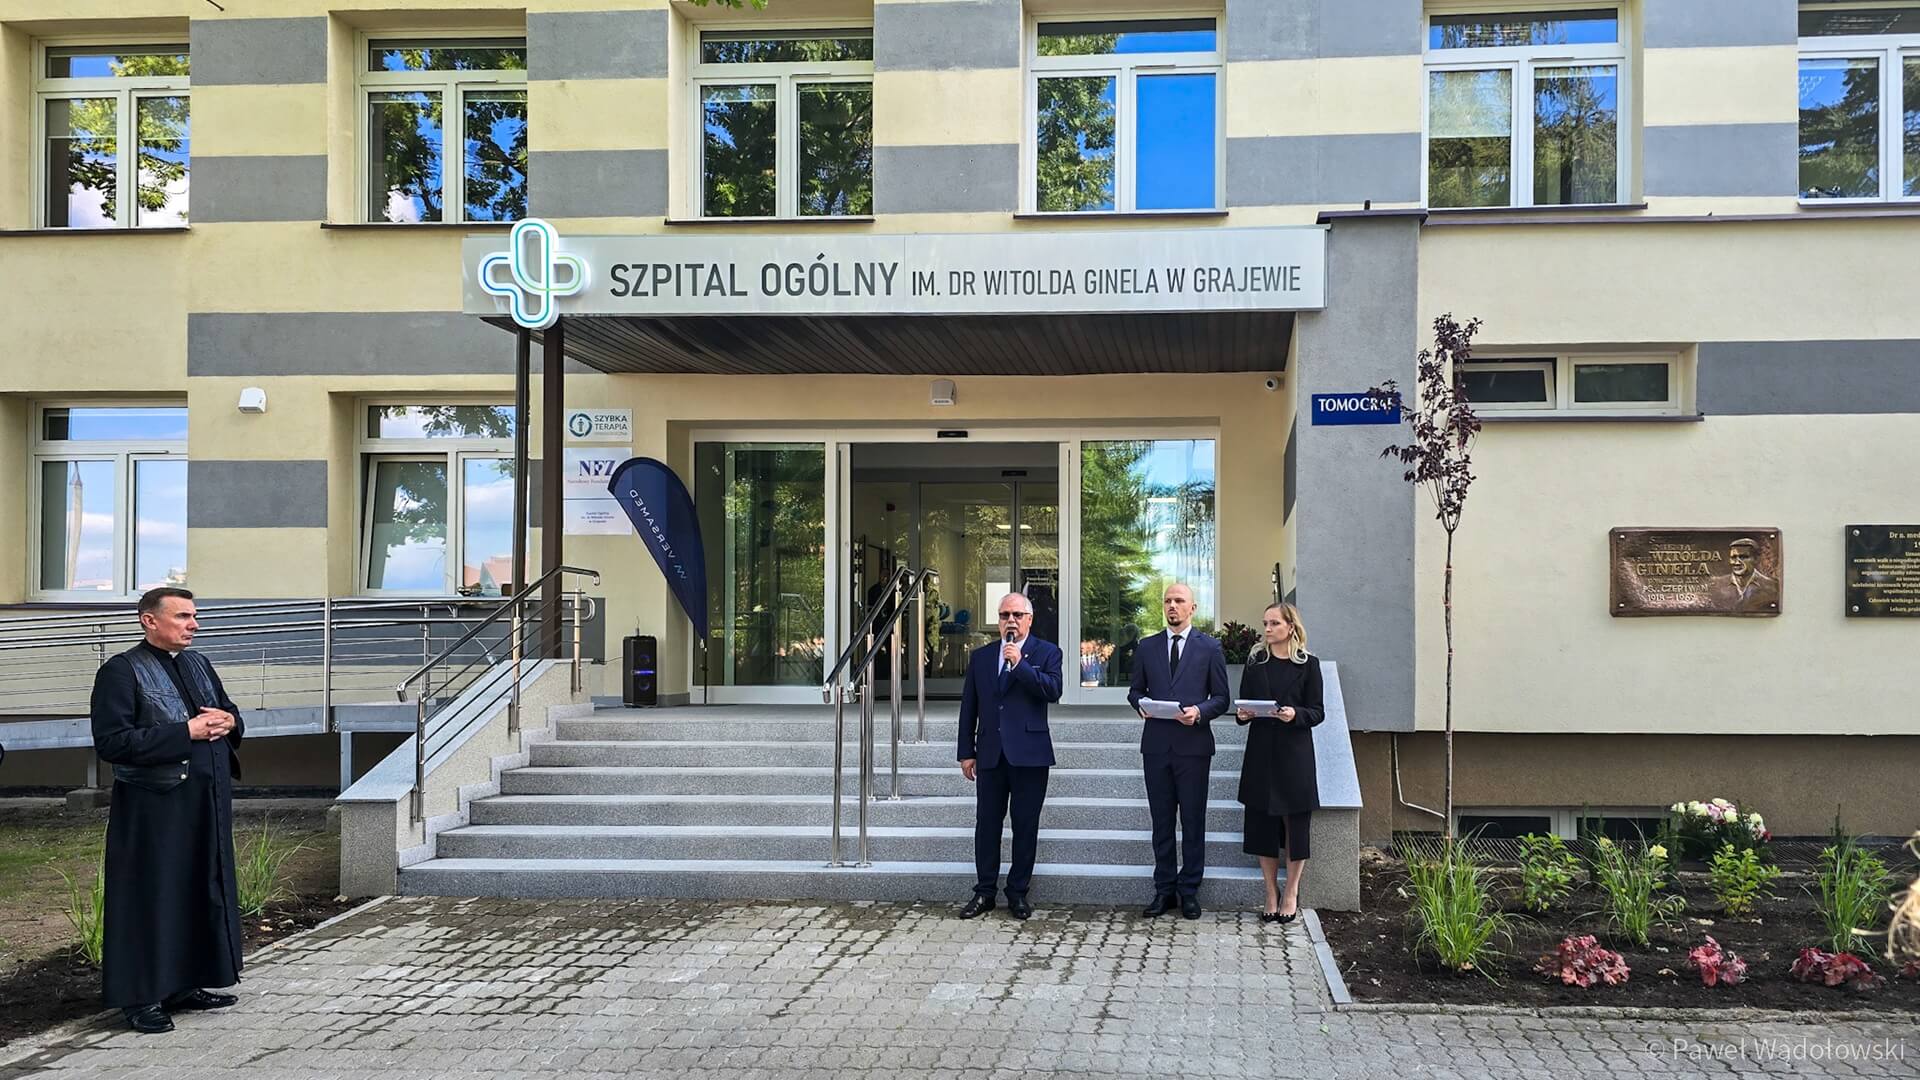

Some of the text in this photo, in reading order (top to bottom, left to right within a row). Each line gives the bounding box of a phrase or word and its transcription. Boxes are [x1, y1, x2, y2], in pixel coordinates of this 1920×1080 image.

[609, 252, 1302, 297] SZPITAL OGÓLNY IM. DR WITOLDA GINELA W GRAJEWIE
[595, 423, 628, 431] TERAPIA
[579, 460, 616, 476] NFZ
[1648, 550, 1722, 561] WITOLDA
[1636, 562, 1711, 576] GINELA
